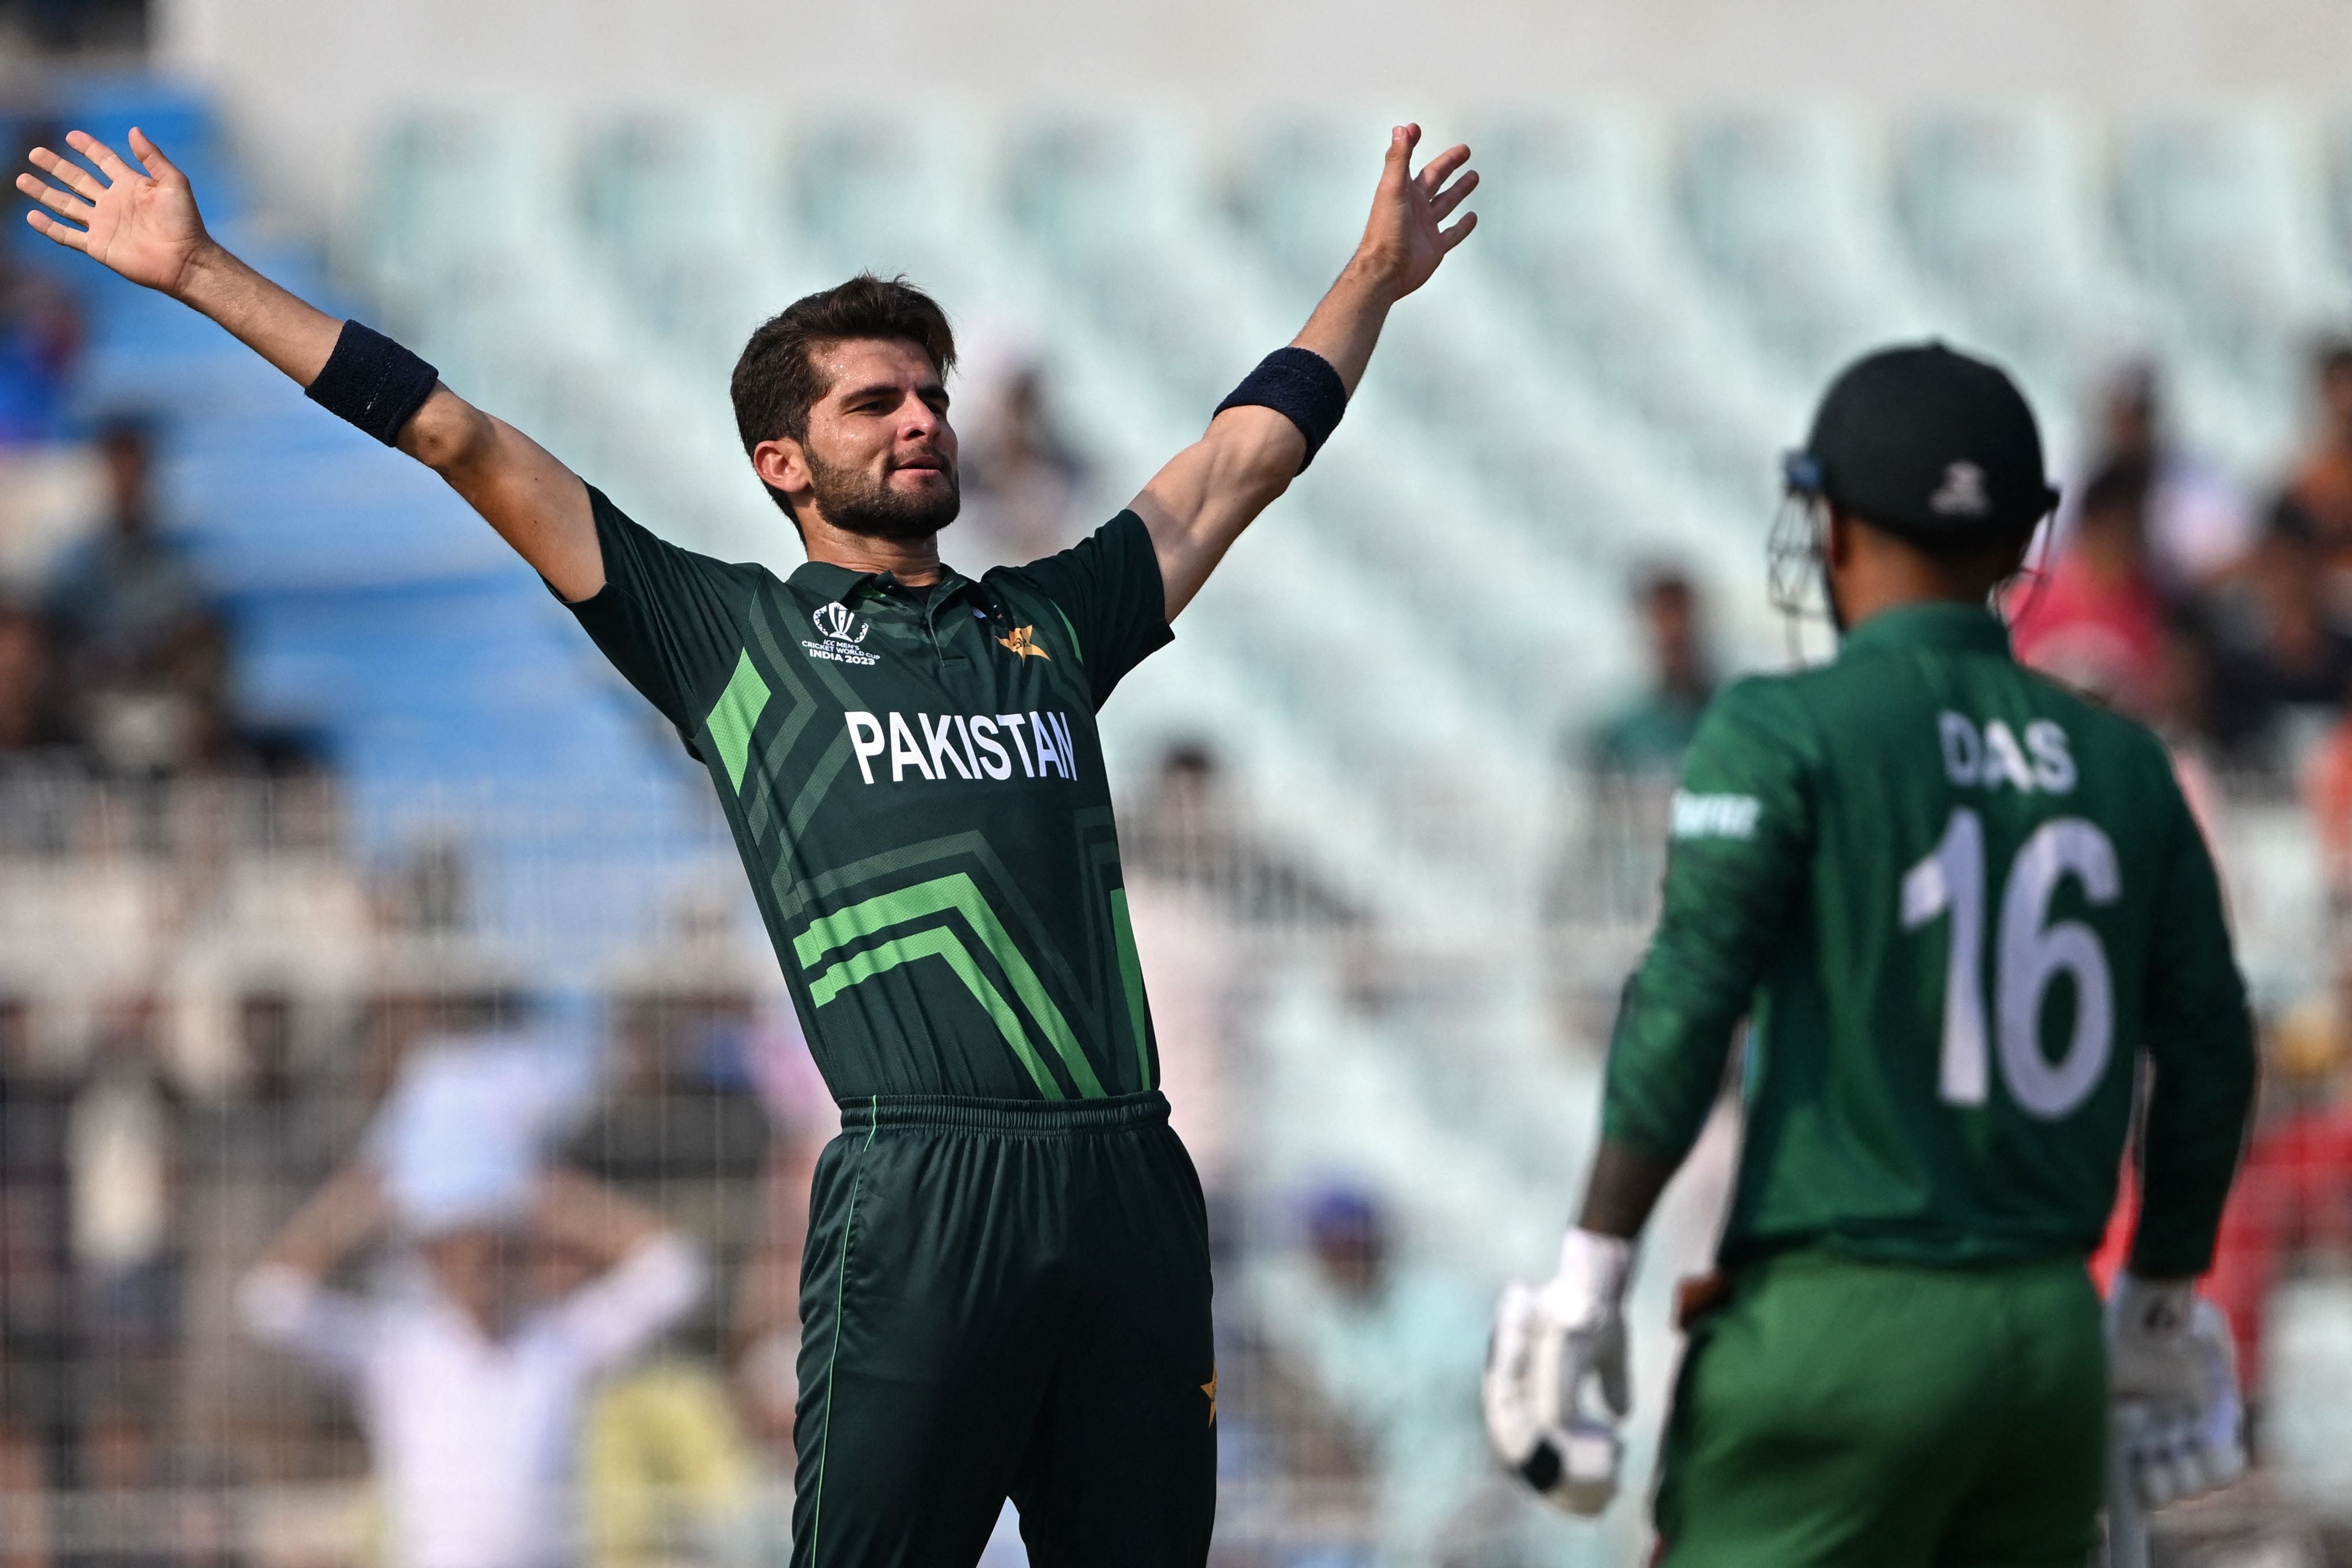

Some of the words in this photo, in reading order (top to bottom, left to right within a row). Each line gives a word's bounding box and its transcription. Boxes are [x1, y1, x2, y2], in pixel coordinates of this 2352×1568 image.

[802, 640, 834, 652] CRICKET
[836, 647, 864, 656] WORLD
[809, 649, 844, 662] INDIA
[845, 655, 875, 665] 2023
[836, 642, 860, 650] MEN'S
[844, 711, 1077, 785] PAKISTAN
[1937, 709, 2078, 795] DAS
[1900, 808, 2121, 1122] 16
